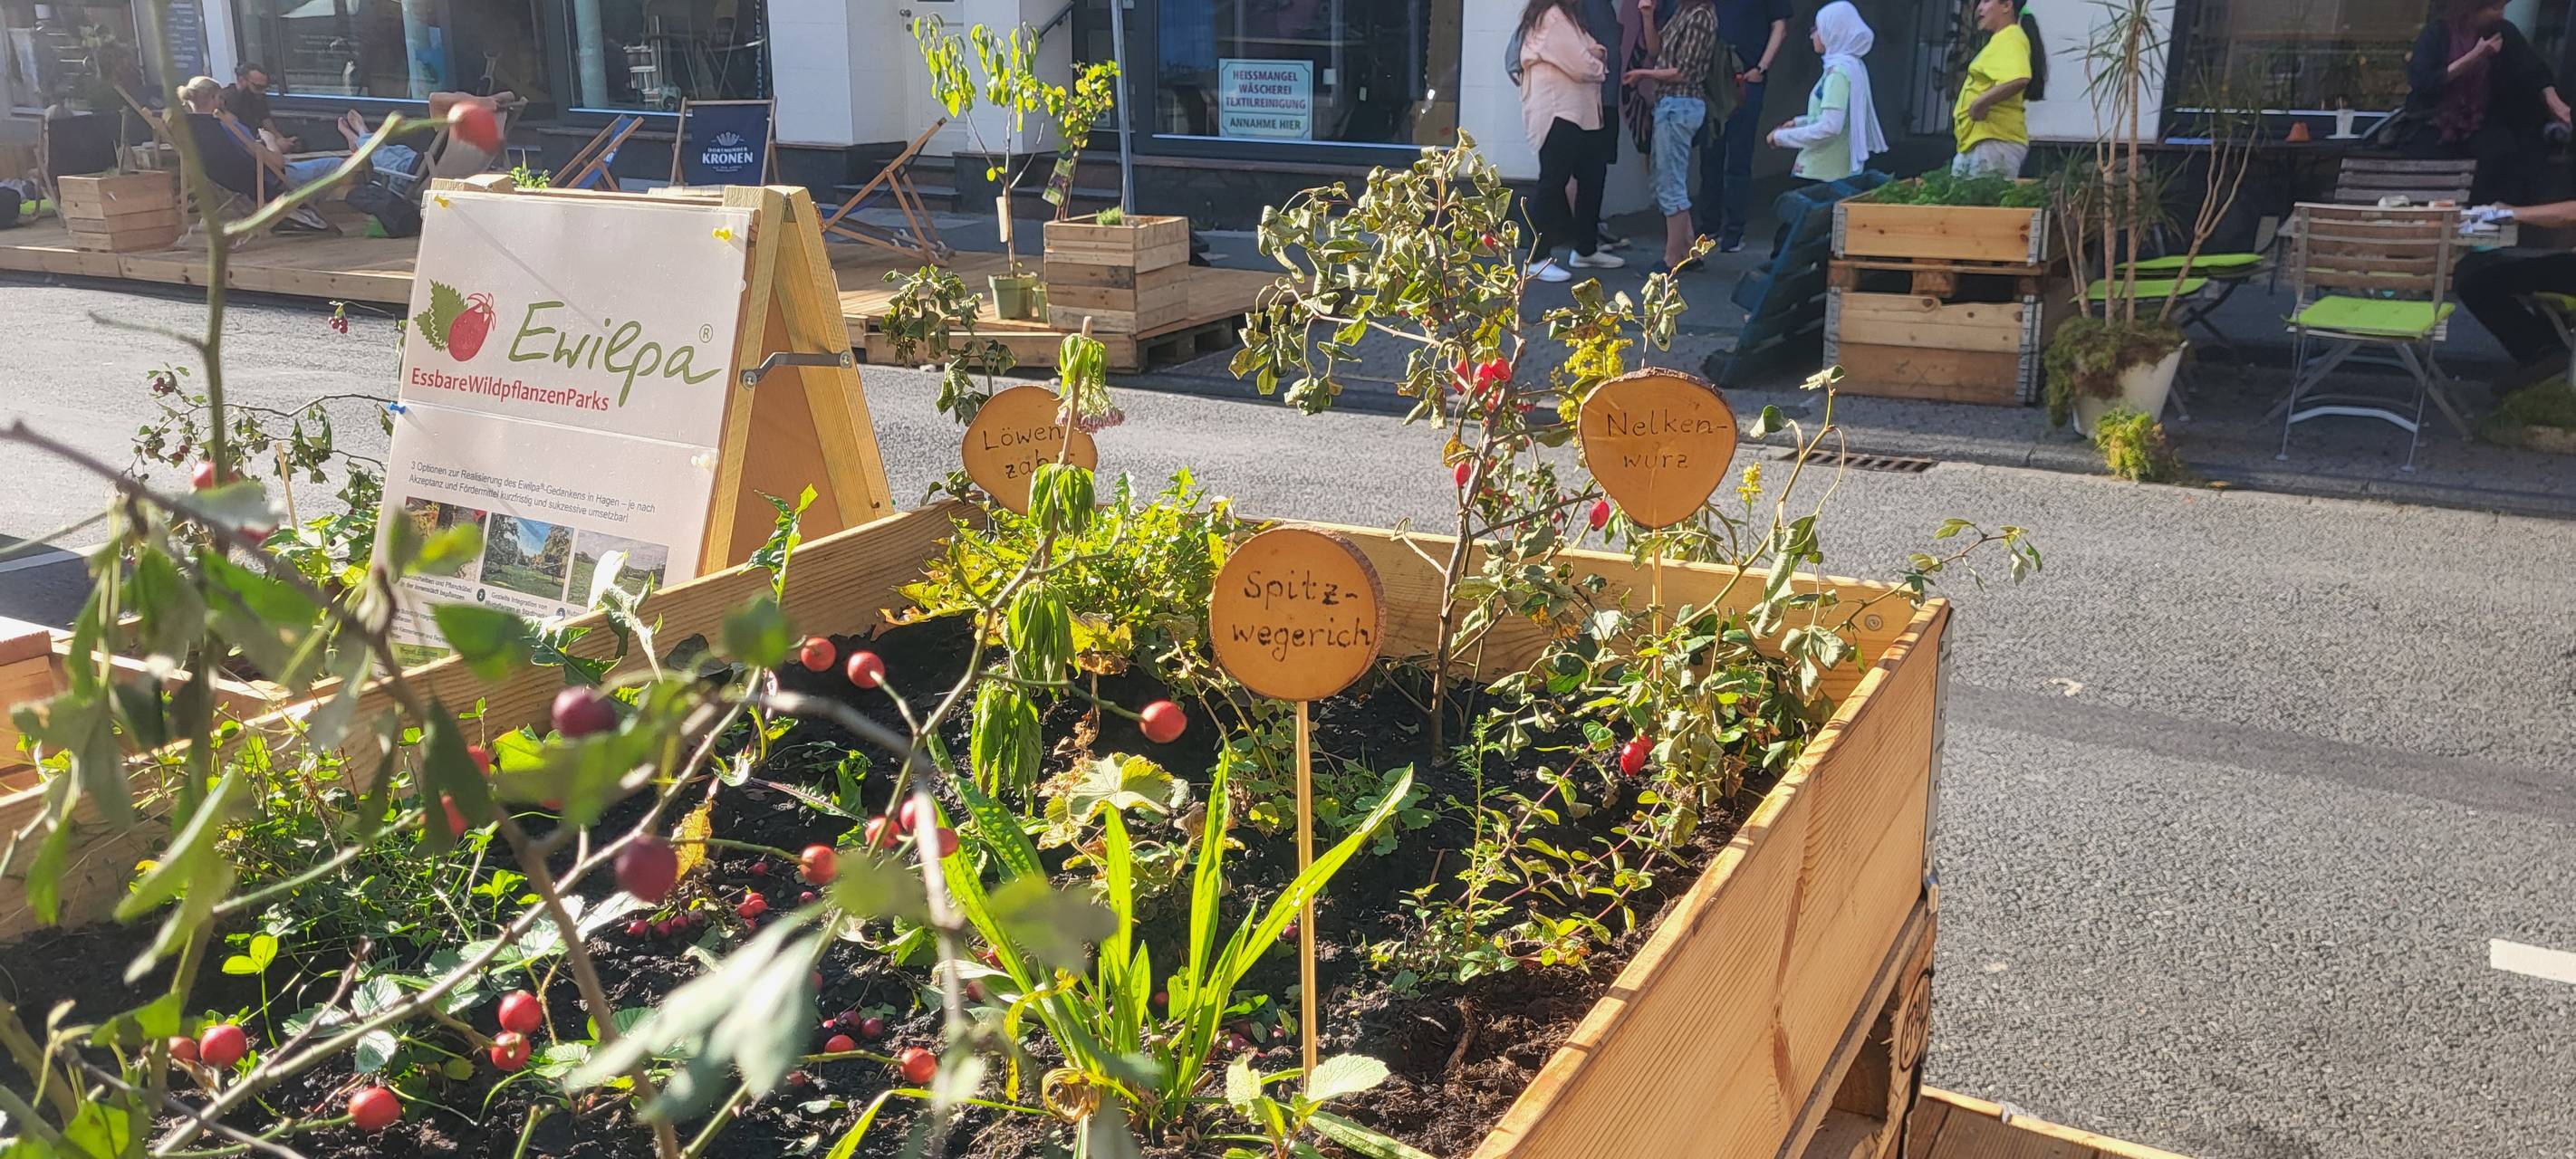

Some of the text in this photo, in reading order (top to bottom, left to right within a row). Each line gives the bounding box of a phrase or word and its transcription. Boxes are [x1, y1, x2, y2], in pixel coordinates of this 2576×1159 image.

[1233, 71, 1298, 81] HEISSMANGEL
[1239, 82, 1292, 95] WÄSCHEREI
[1226, 97, 1306, 110] TEXTILREINIGUNG
[1231, 118, 1301, 130] ANNAHME HIER
[702, 152, 753, 164] KRONEN
[411, 367, 610, 411] EssbareWildpflanzenParks
[1607, 408, 1728, 437] Nelken-
[1624, 454, 1688, 469] wurz
[409, 474, 443, 488] Akzeptanz
[445, 482, 458, 491] und
[459, 483, 499, 498] Fördermittel
[500, 491, 533, 506] kurzfristig
[534, 498, 547, 507] und
[549, 500, 587, 514] sukzessive
[410, 461, 416, 469] 3
[417, 462, 447, 475] Optionen
[448, 470, 459, 478] zur
[461, 469, 502, 487] Realisierung
[504, 478, 516, 489] des
[588, 493, 594, 502] in
[596, 494, 620, 507] Hagen
[627, 499, 635, 511] je
[637, 502, 656, 513] nach
[1245, 570, 1359, 610] Spitz-
[1232, 618, 1370, 663] wegerich
